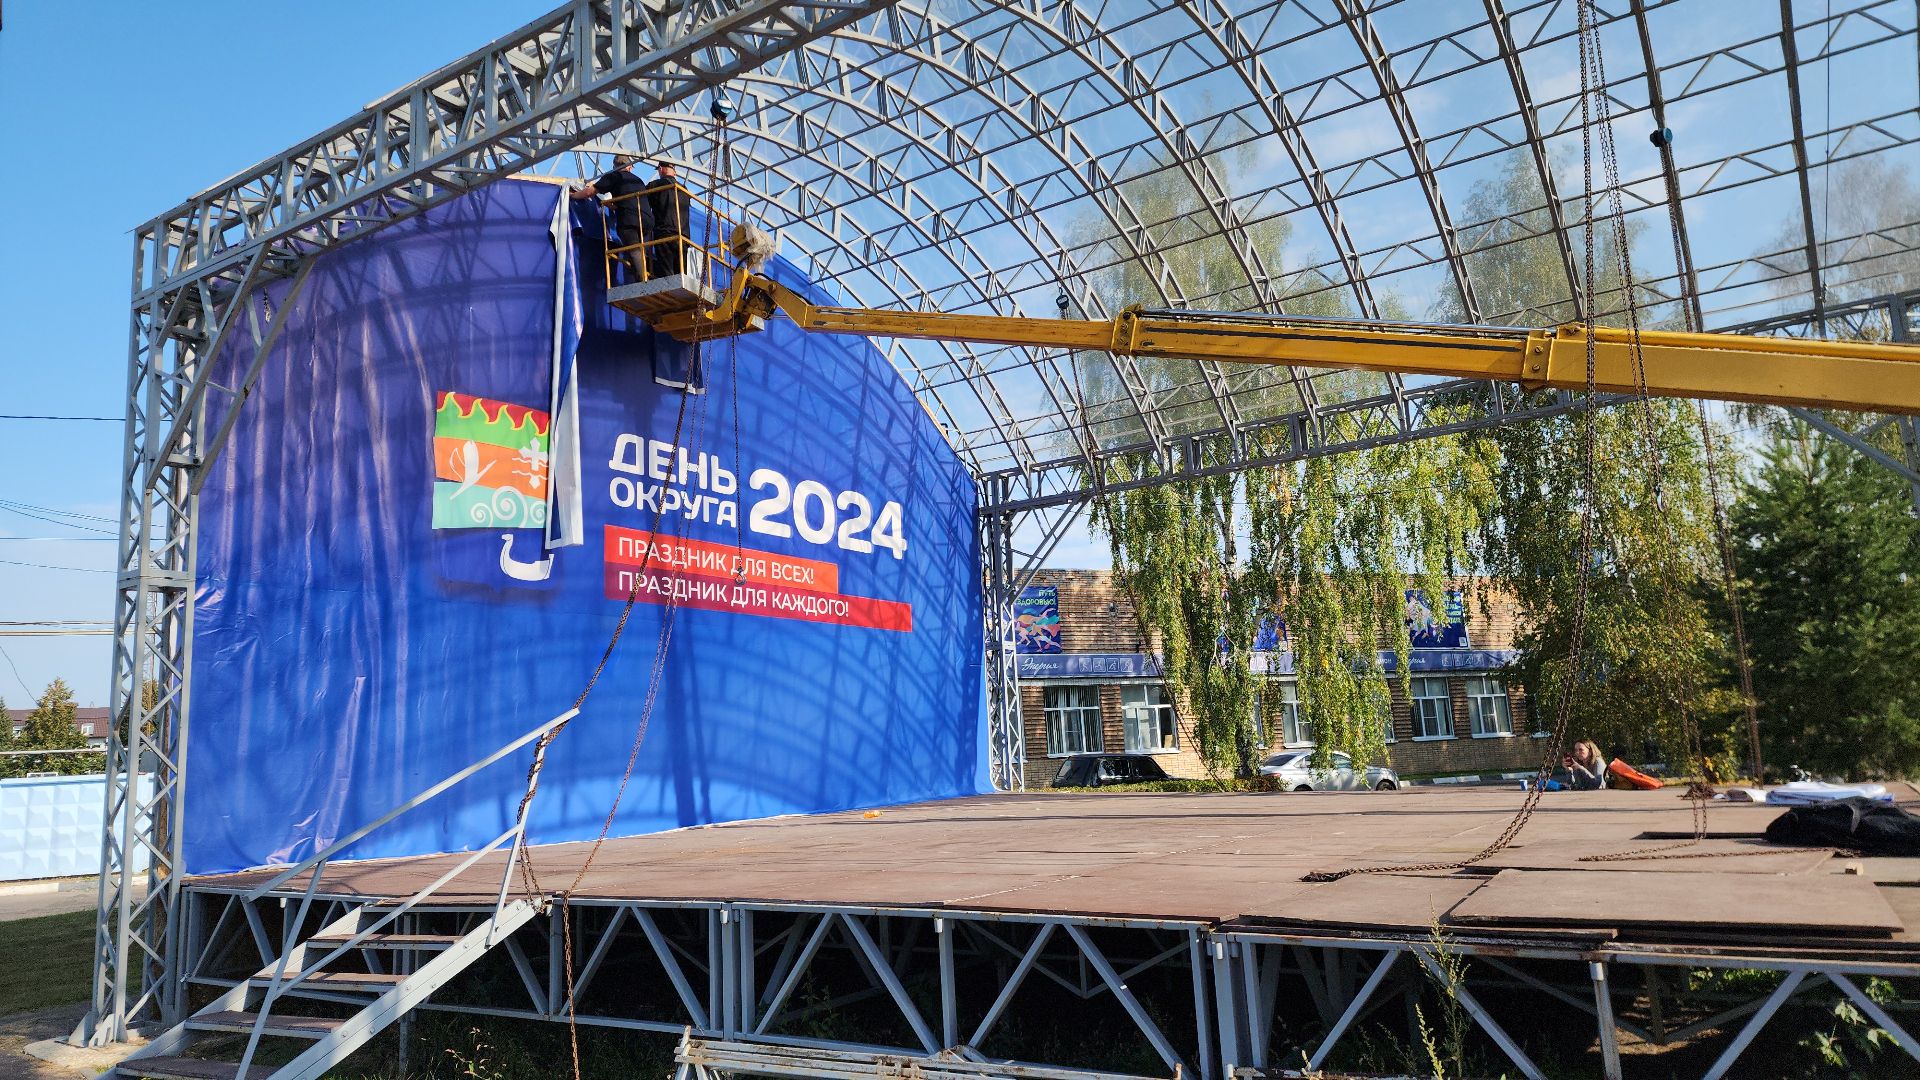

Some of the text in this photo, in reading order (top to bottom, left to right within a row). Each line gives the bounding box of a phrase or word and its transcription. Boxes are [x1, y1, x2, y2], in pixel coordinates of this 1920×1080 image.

[609, 433, 737, 495] ДЕНЬ
[609, 477, 737, 528] ОКРУГА
[749, 468, 907, 560] 2024
[619, 536, 727, 572] ПРАЗДНИК
[771, 562, 815, 585] ВСЕХ!
[618, 570, 849, 618] ПРАЗДНИК ДЛЯ КАЖДОГО!
